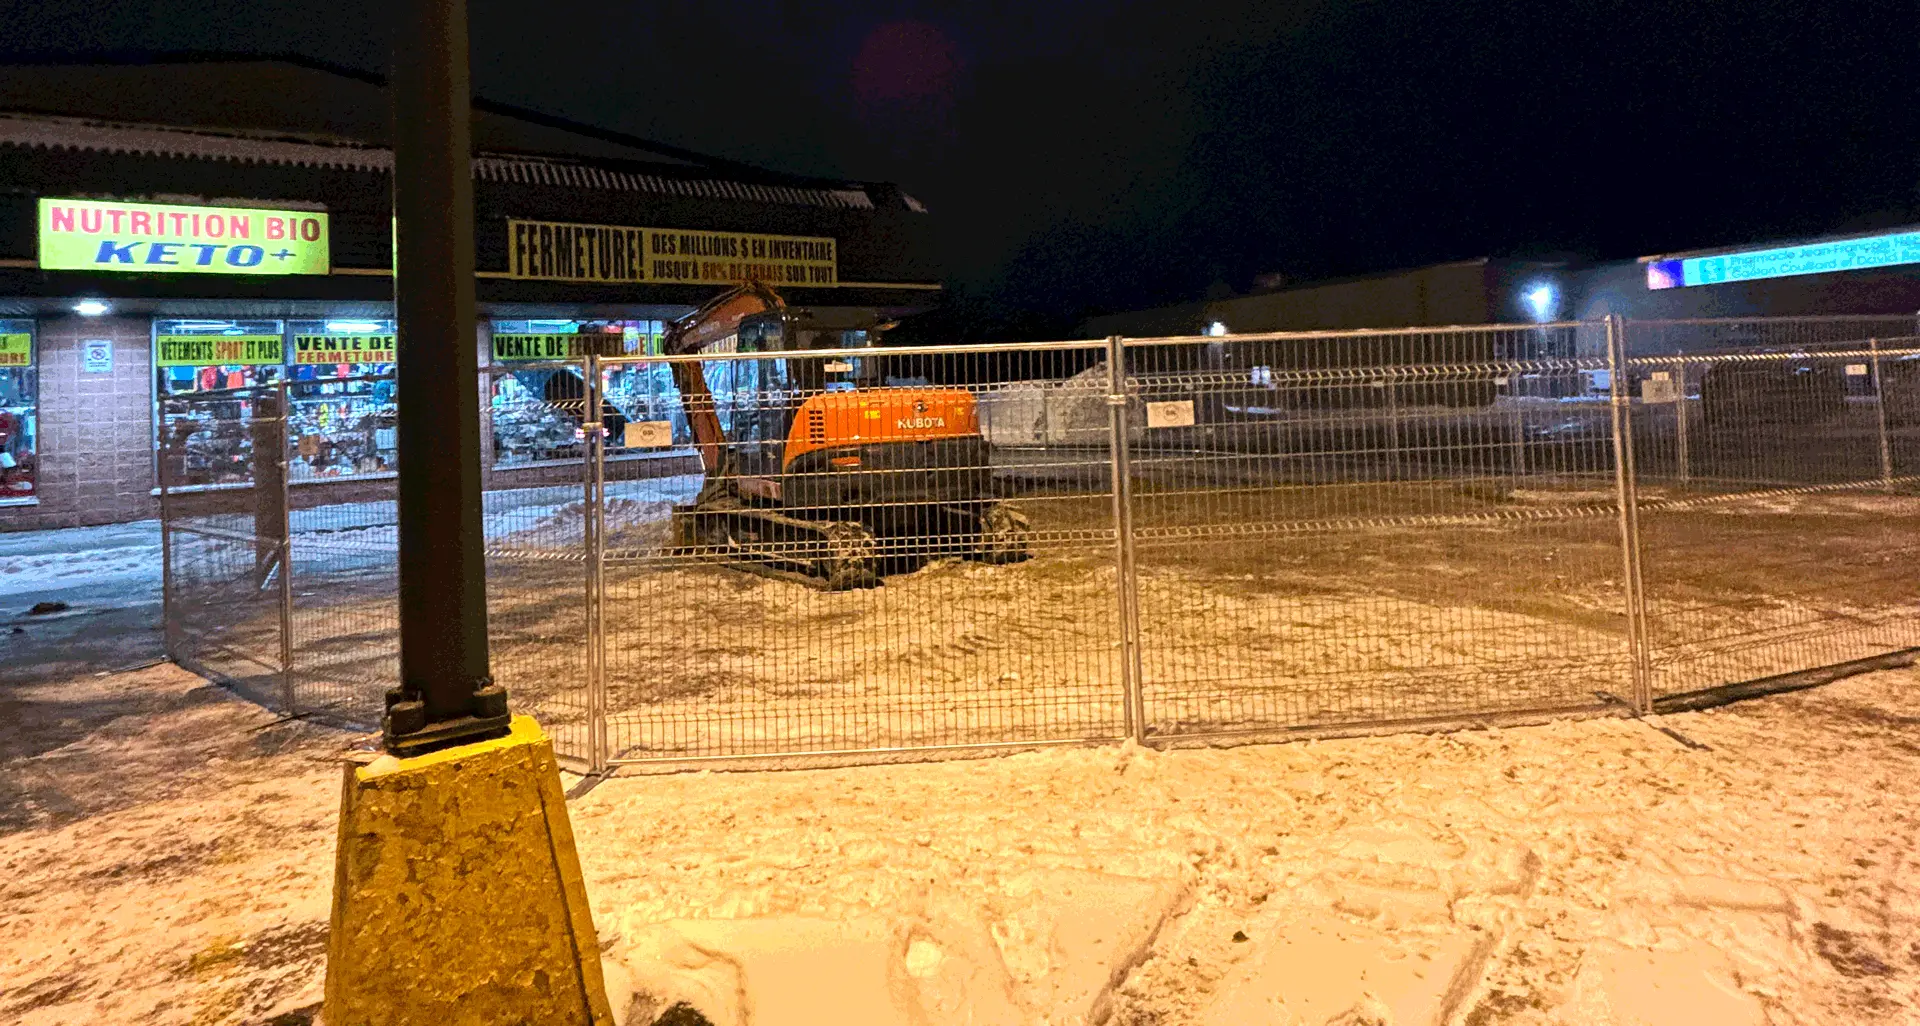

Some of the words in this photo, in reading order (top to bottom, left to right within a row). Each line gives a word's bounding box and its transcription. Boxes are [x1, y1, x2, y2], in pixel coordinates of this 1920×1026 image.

[51, 207, 250, 240] NUTRITION
[266, 217, 320, 241] BIO
[94, 241, 296, 267] KETO+
[516, 224, 644, 279] FERMETURE!
[652, 234, 676, 255] DES
[680, 235, 737, 258] MILLIONS
[752, 239, 766, 259] EN
[769, 240, 832, 261] INVENTAIRE
[652, 259, 699, 280] JUSQU'À
[786, 266, 805, 283] SUR
[809, 267, 833, 284] TOUT
[215, 341, 243, 360] SPORT
[246, 341, 256, 359] ET
[258, 341, 279, 360] PLUS
[296, 337, 362, 350] VENTE
[369, 337, 394, 350] DE
[495, 336, 541, 357] VENTE
[545, 337, 563, 357] DE
[568, 337, 646, 356] FERMETE
[296, 350, 394, 364] FERMETURE
[897, 416, 945, 429] KUBOTA
